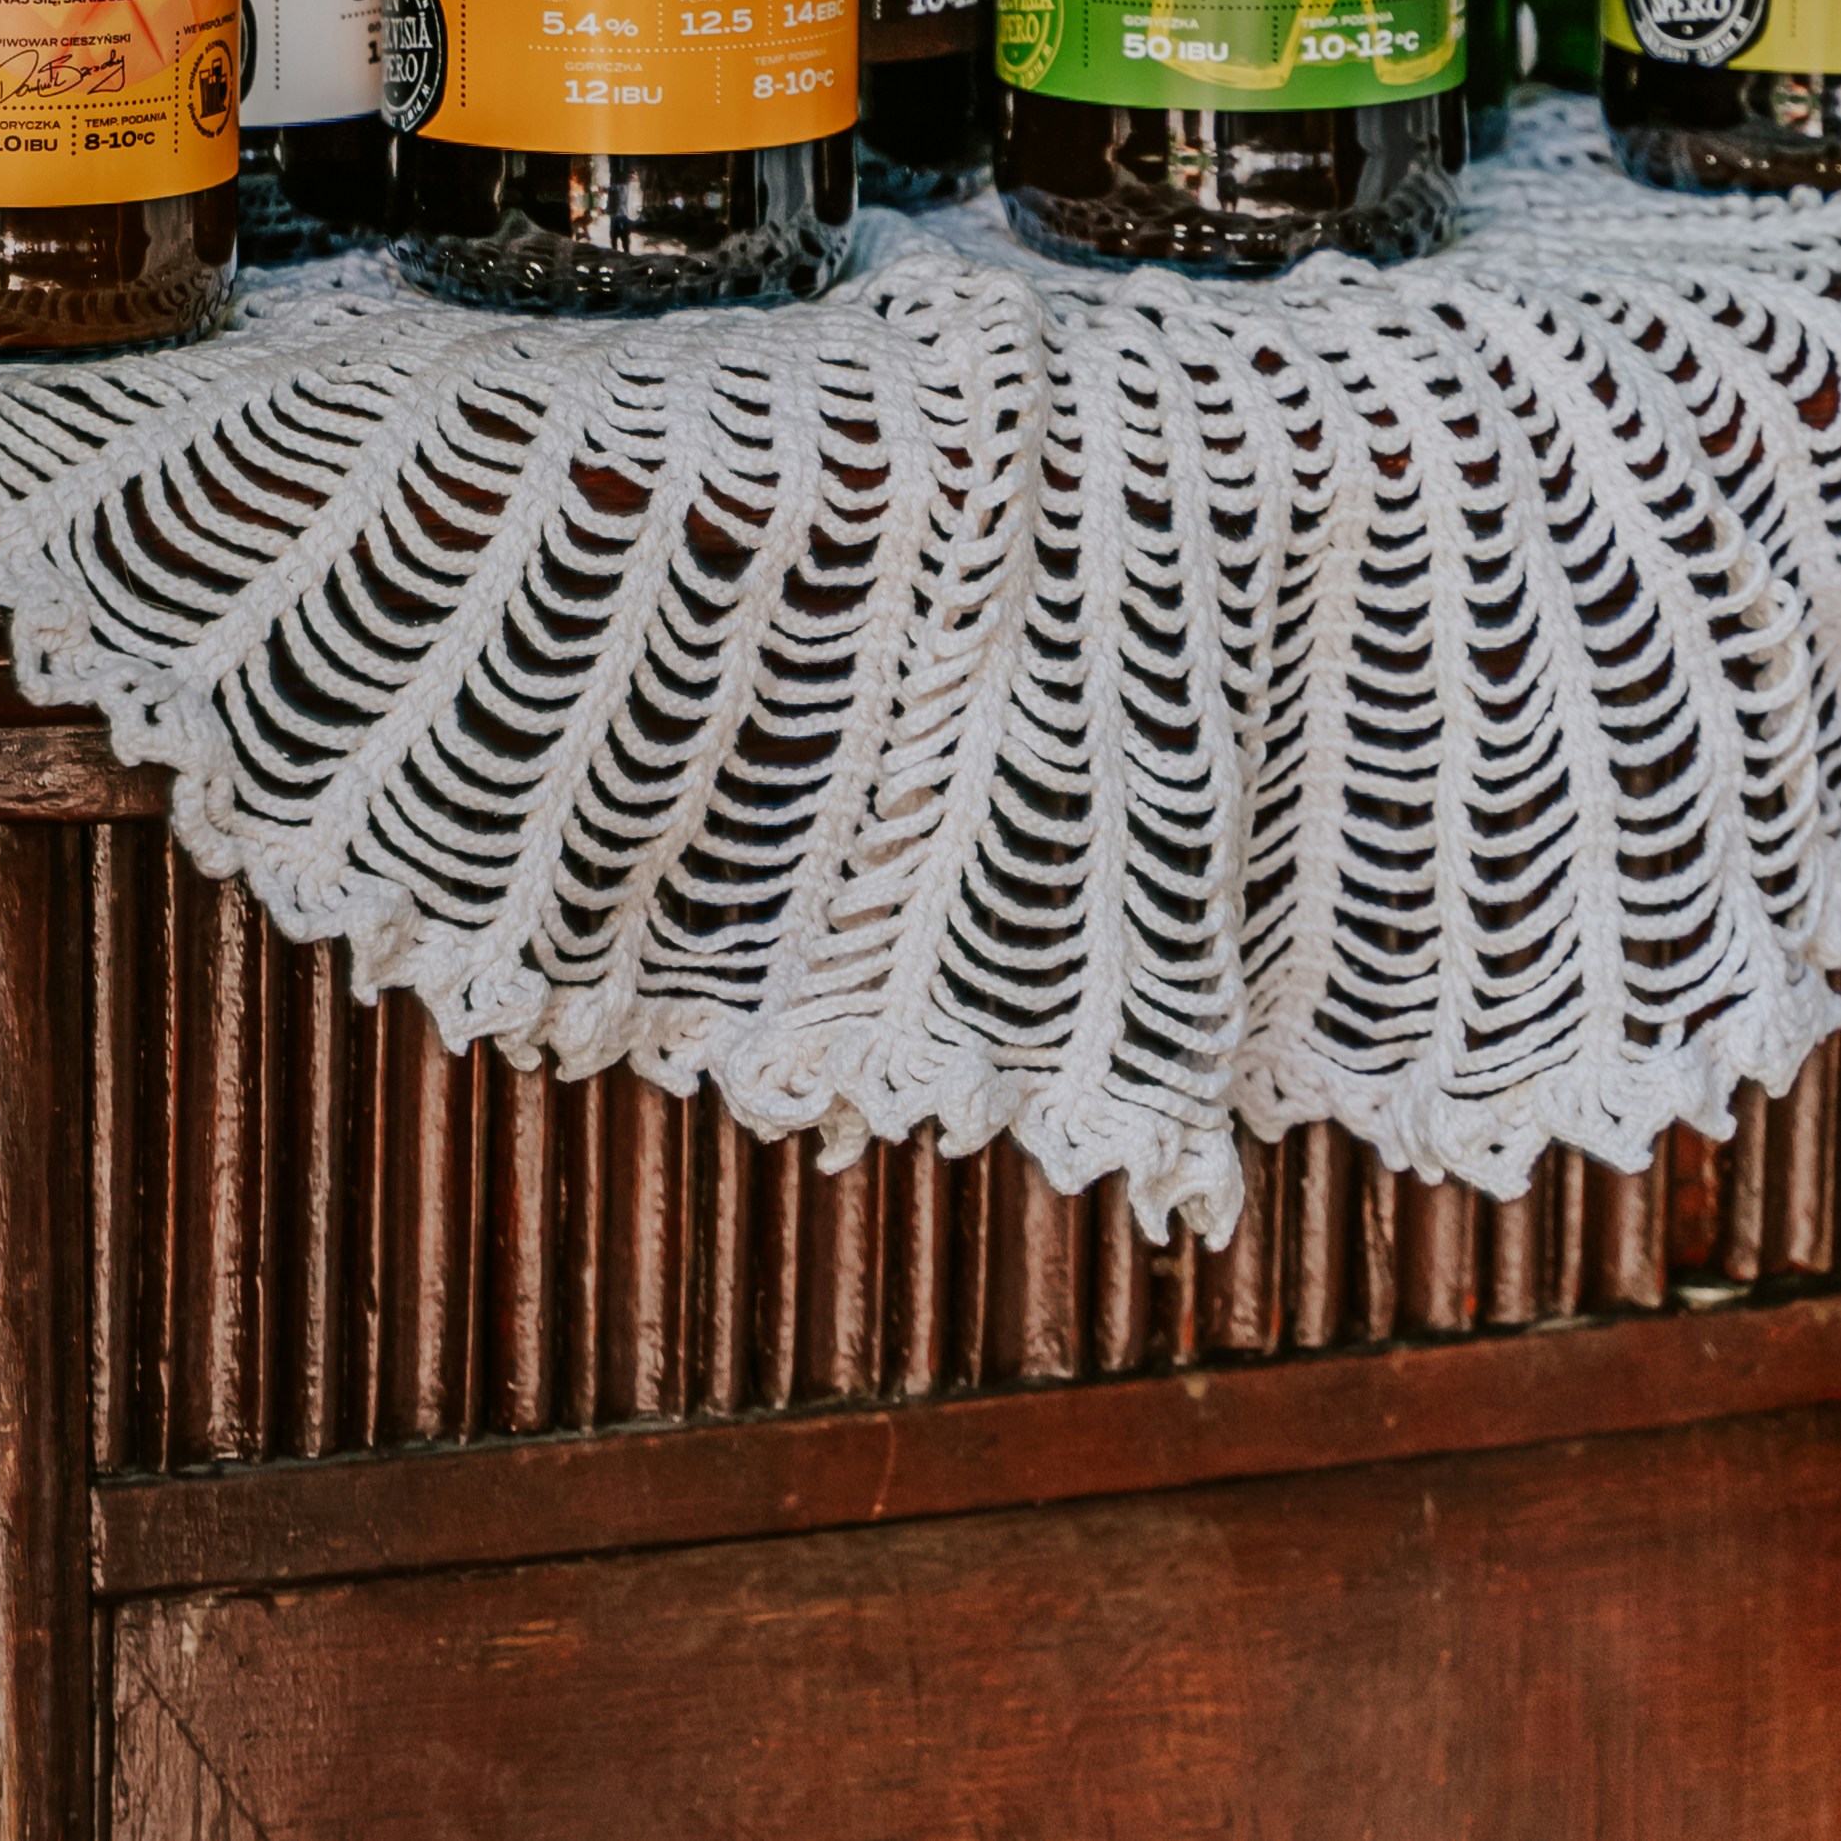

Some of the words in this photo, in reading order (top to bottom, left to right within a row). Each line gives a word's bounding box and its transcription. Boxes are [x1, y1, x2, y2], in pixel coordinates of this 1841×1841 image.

[783, 0, 816, 28] 14
[1122, 14, 1200, 30] GORYCZKA
[183, 24, 197, 36] WE
[542, 10, 639, 38] 5.4%
[679, 9, 753, 37] 12.5
[60, 33, 131, 47] CIESZYŃSKI
[1122, 33, 1173, 61] 50
[1178, 41, 1229, 63] IBU
[564, 62, 643, 73] GORYCZKA
[564, 80, 609, 104] 12
[613, 86, 663, 105] IBU
[85, 118, 118, 129] TEMP.
[121, 112, 167, 126] PODANIA
[25, 139, 58, 152] IBU
